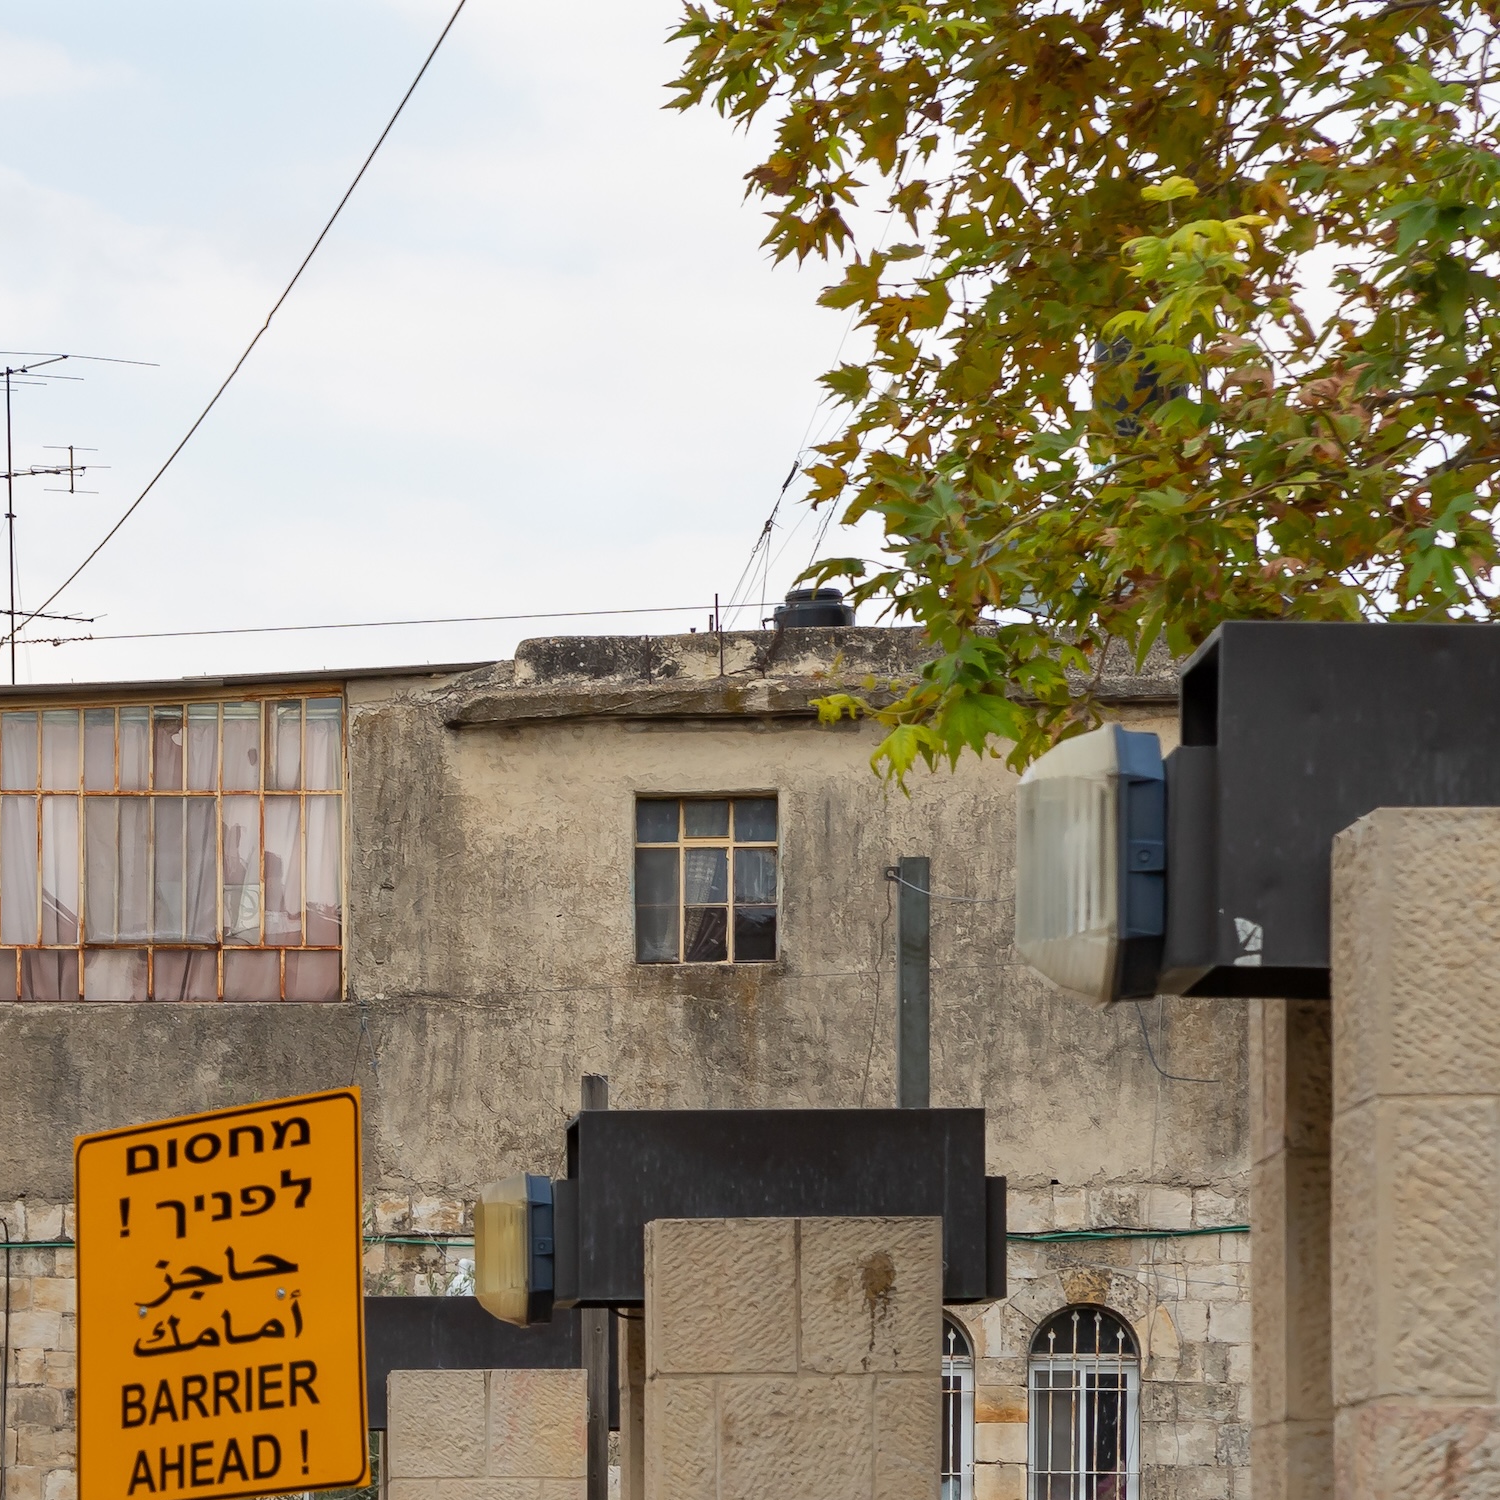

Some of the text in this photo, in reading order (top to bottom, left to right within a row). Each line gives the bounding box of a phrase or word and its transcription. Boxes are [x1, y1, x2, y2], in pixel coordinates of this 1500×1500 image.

[126, 1116, 311, 1176] מחסום
[156, 1169, 312, 1239] לפניך
[134, 1246, 298, 1308] حاجز
[133, 1289, 303, 1357] أمامك
[121, 1360, 320, 1429] BARRIER
[127, 1429, 309, 1496] AHEAD !
